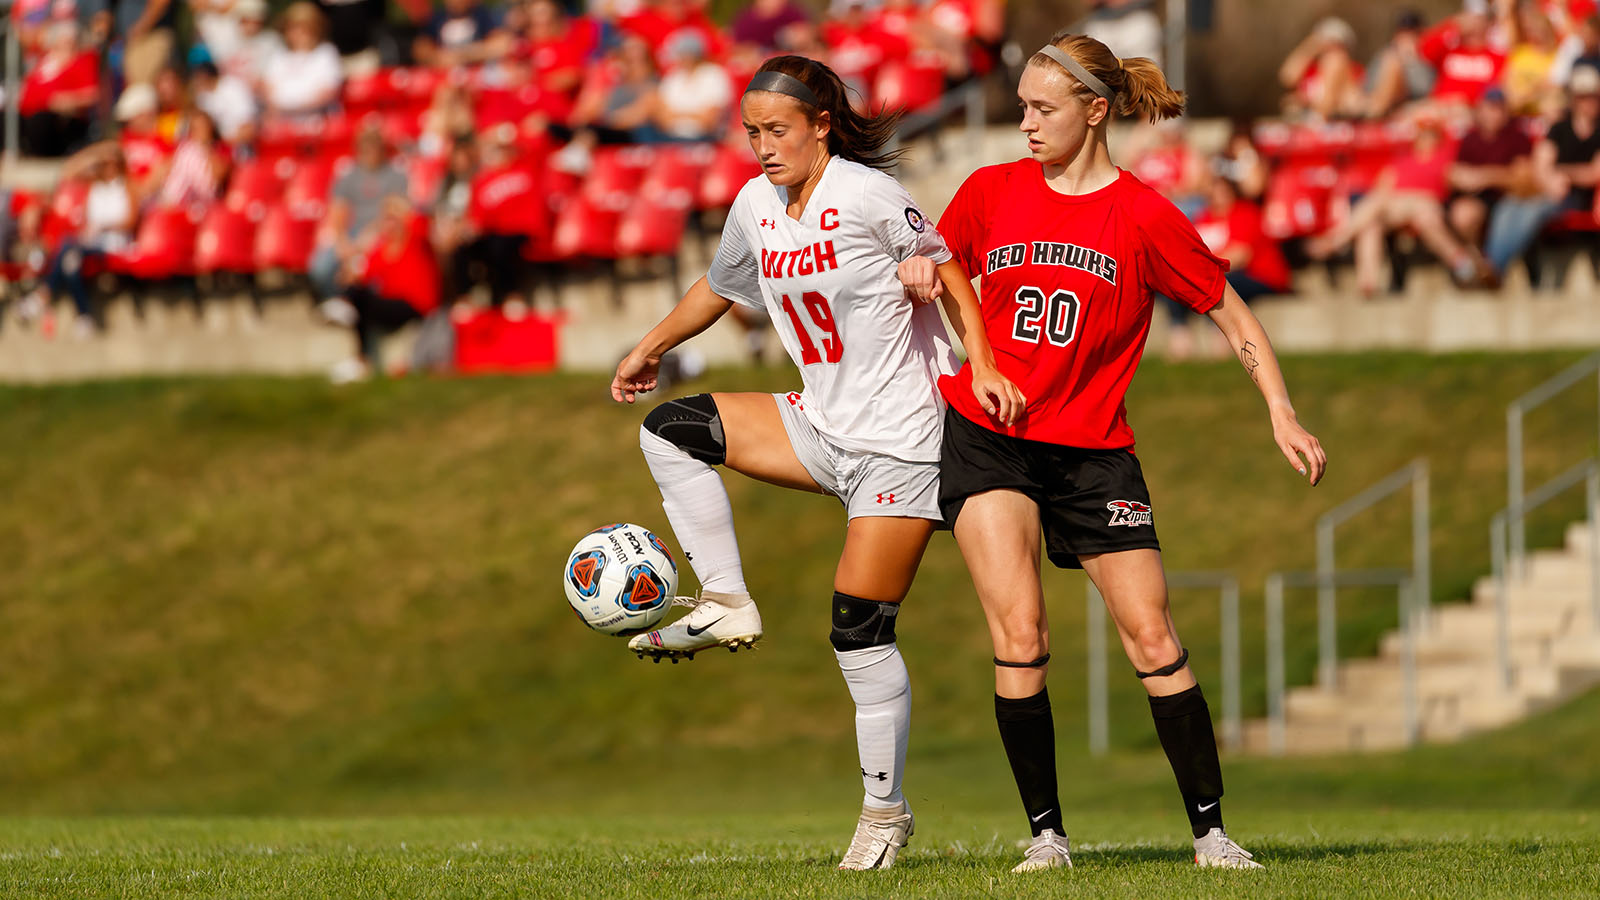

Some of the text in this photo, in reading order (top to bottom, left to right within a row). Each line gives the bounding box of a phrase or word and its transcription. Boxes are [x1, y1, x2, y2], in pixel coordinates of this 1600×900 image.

[820, 207, 840, 231] C
[761, 240, 838, 279] DUTCH
[987, 241, 1117, 286] RED HAWKS
[782, 291, 844, 366] 19
[1012, 285, 1081, 348] 20
[608, 534, 628, 564] Wilson
